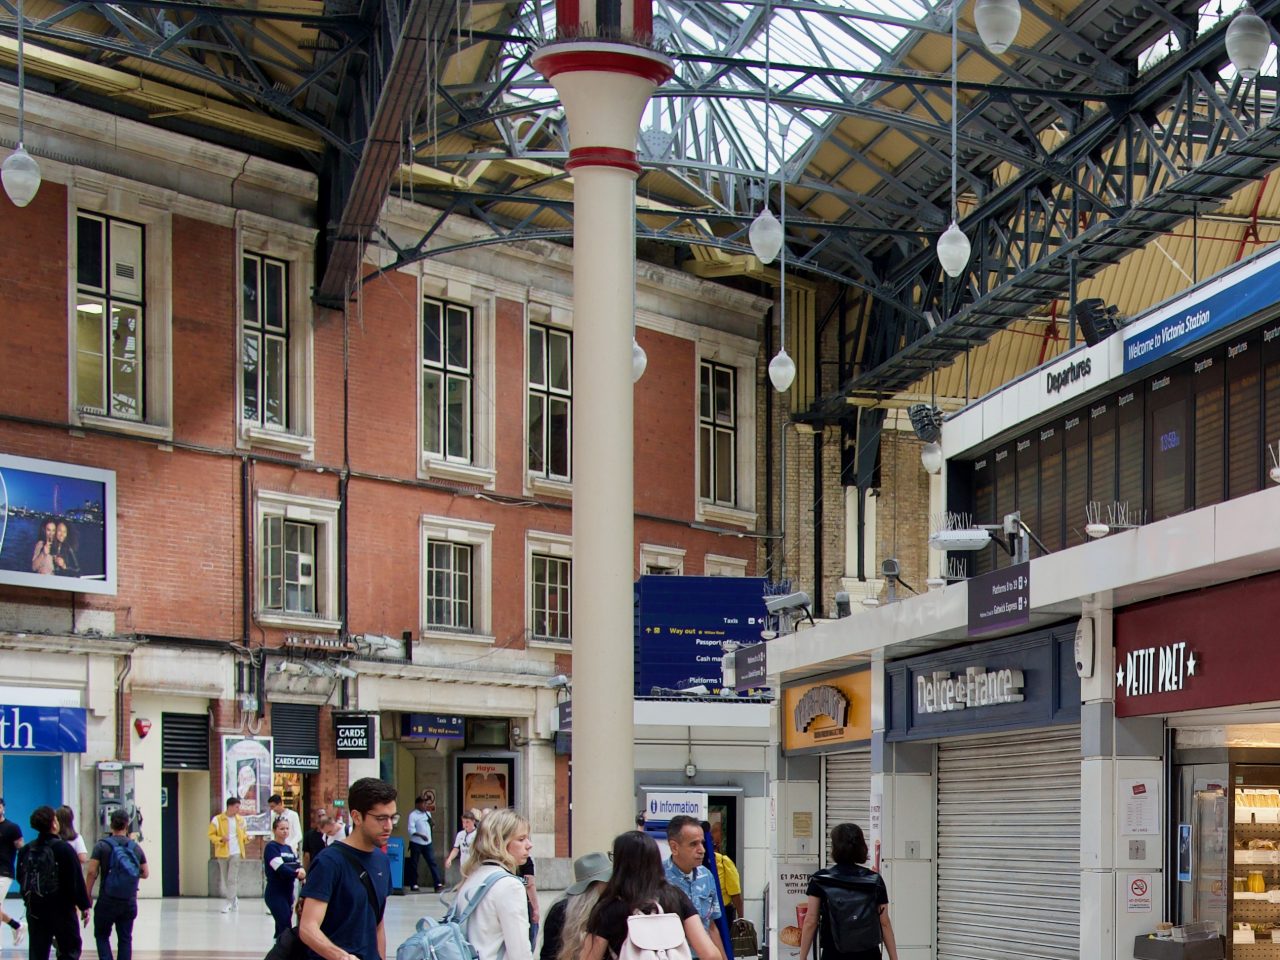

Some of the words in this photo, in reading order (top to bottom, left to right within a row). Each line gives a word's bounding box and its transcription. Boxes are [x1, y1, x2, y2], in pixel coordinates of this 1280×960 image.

[1128, 338, 1154, 361] Welcome
[1154, 335, 1161, 348] to
[1161, 320, 1185, 344] Victoria
[1185, 309, 1210, 333] Station
[1228, 342, 1248, 359] Departures
[1194, 358, 1213, 374] Departures
[1047, 357, 1092, 394] Departures
[669, 627, 684, 636] Way
[695, 638, 722, 647] Passport
[1126, 647, 1156, 697] PETIT
[1158, 641, 1186, 693] PRET
[917, 671, 955, 714] Delice
[955, 676, 968, 702] de
[966, 667, 1013, 707] France
[339, 729, 365, 737] CARDS
[337, 738, 367, 747] GALORE
[296, 758, 319, 766] GALORE
[660, 800, 699, 813] Information
[790, 873, 811, 881] PASTR
